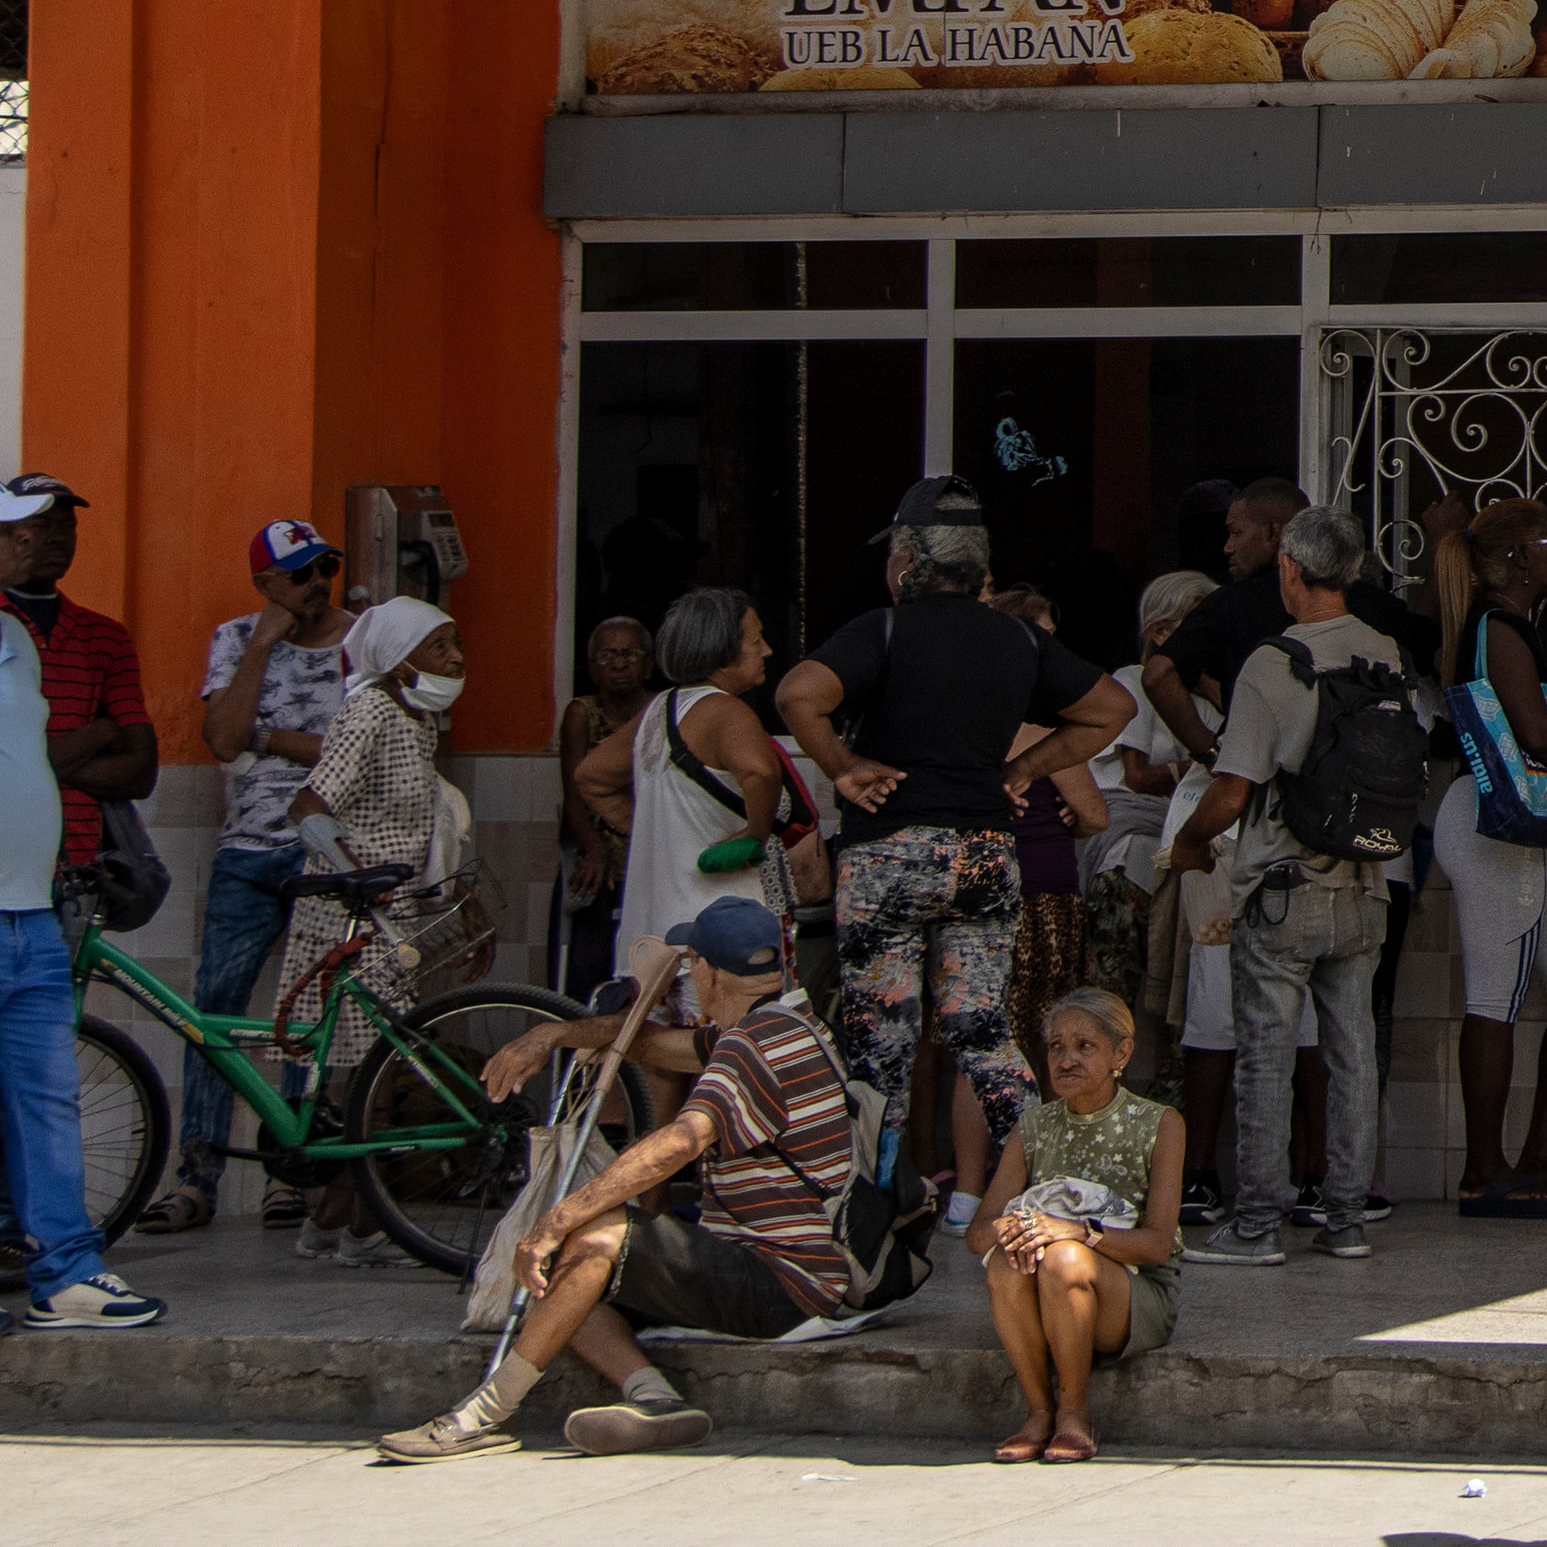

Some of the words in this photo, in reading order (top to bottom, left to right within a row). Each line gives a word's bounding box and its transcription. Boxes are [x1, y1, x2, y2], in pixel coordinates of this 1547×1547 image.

[784, 29, 864, 65] UEB
[876, 27, 934, 63] LA
[945, 22, 1131, 63] HABANA
